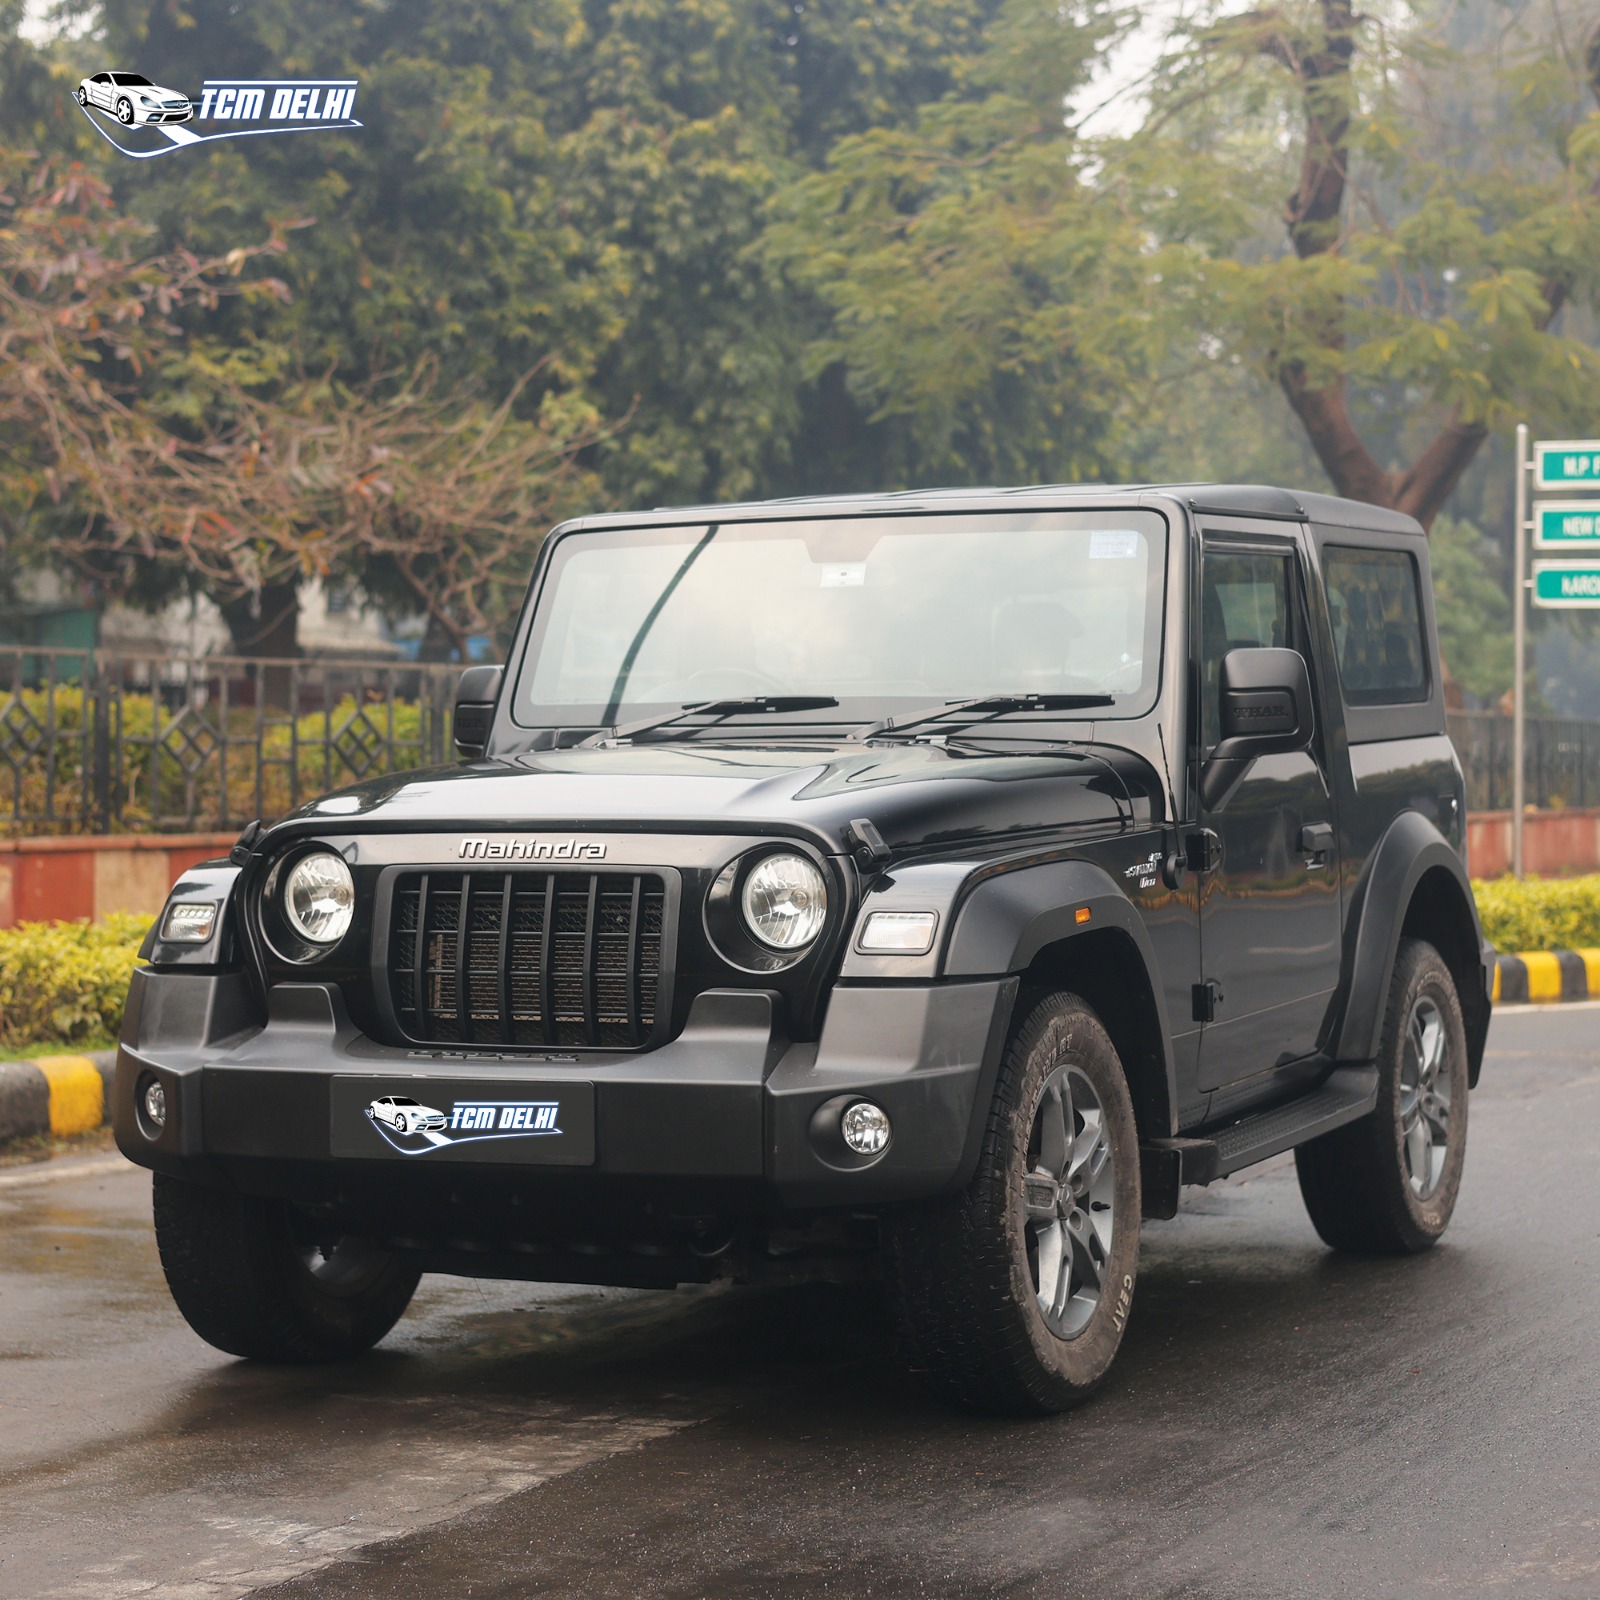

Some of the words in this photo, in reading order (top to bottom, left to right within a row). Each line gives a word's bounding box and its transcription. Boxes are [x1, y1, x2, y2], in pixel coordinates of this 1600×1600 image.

[1562, 516, 1593, 537] NEW
[1561, 575, 1600, 596] KARO
[458, 838, 608, 859] Mahindra
[1112, 1274, 1133, 1333] CEAT
